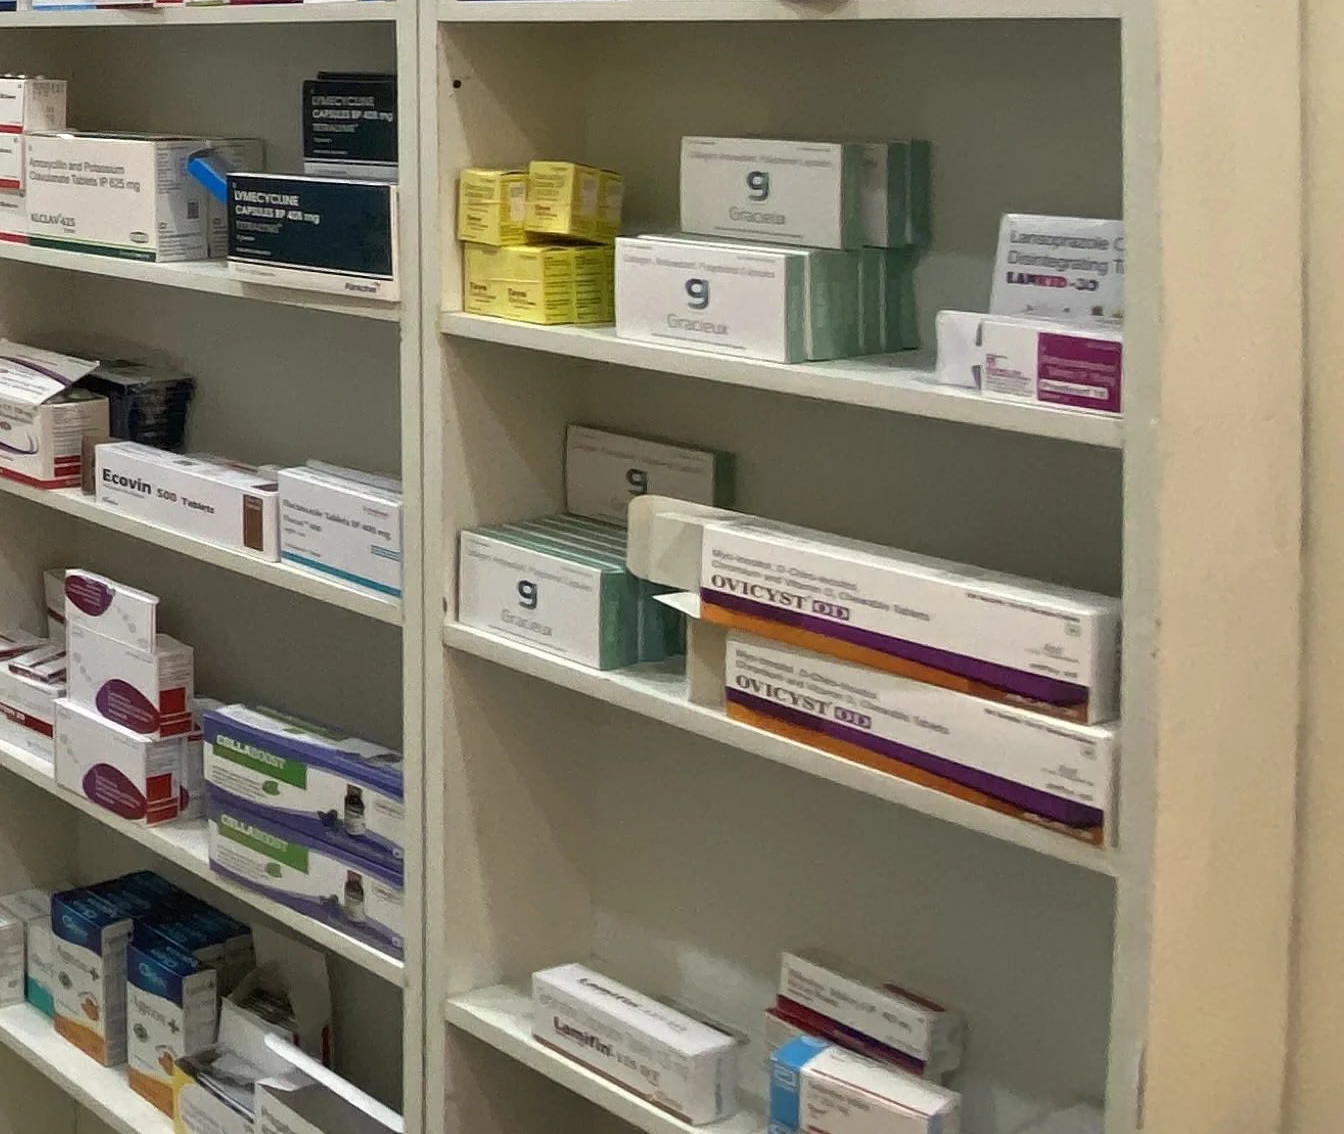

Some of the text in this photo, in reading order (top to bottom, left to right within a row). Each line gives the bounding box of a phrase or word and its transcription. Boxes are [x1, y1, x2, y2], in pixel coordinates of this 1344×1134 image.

[379, 111, 393, 123] mg
[67, 161, 83, 172] and
[126, 180, 141, 193] mg
[233, 190, 300, 207] LYMECYCLINE
[746, 170, 770, 202] g
[303, 213, 321, 226] mg
[684, 278, 710, 310] g
[102, 467, 215, 515] Ecovin 500 Tablets
[517, 579, 539, 610] g
[711, 573, 805, 610] OVICYST
[735, 673, 832, 716] OVICYST
